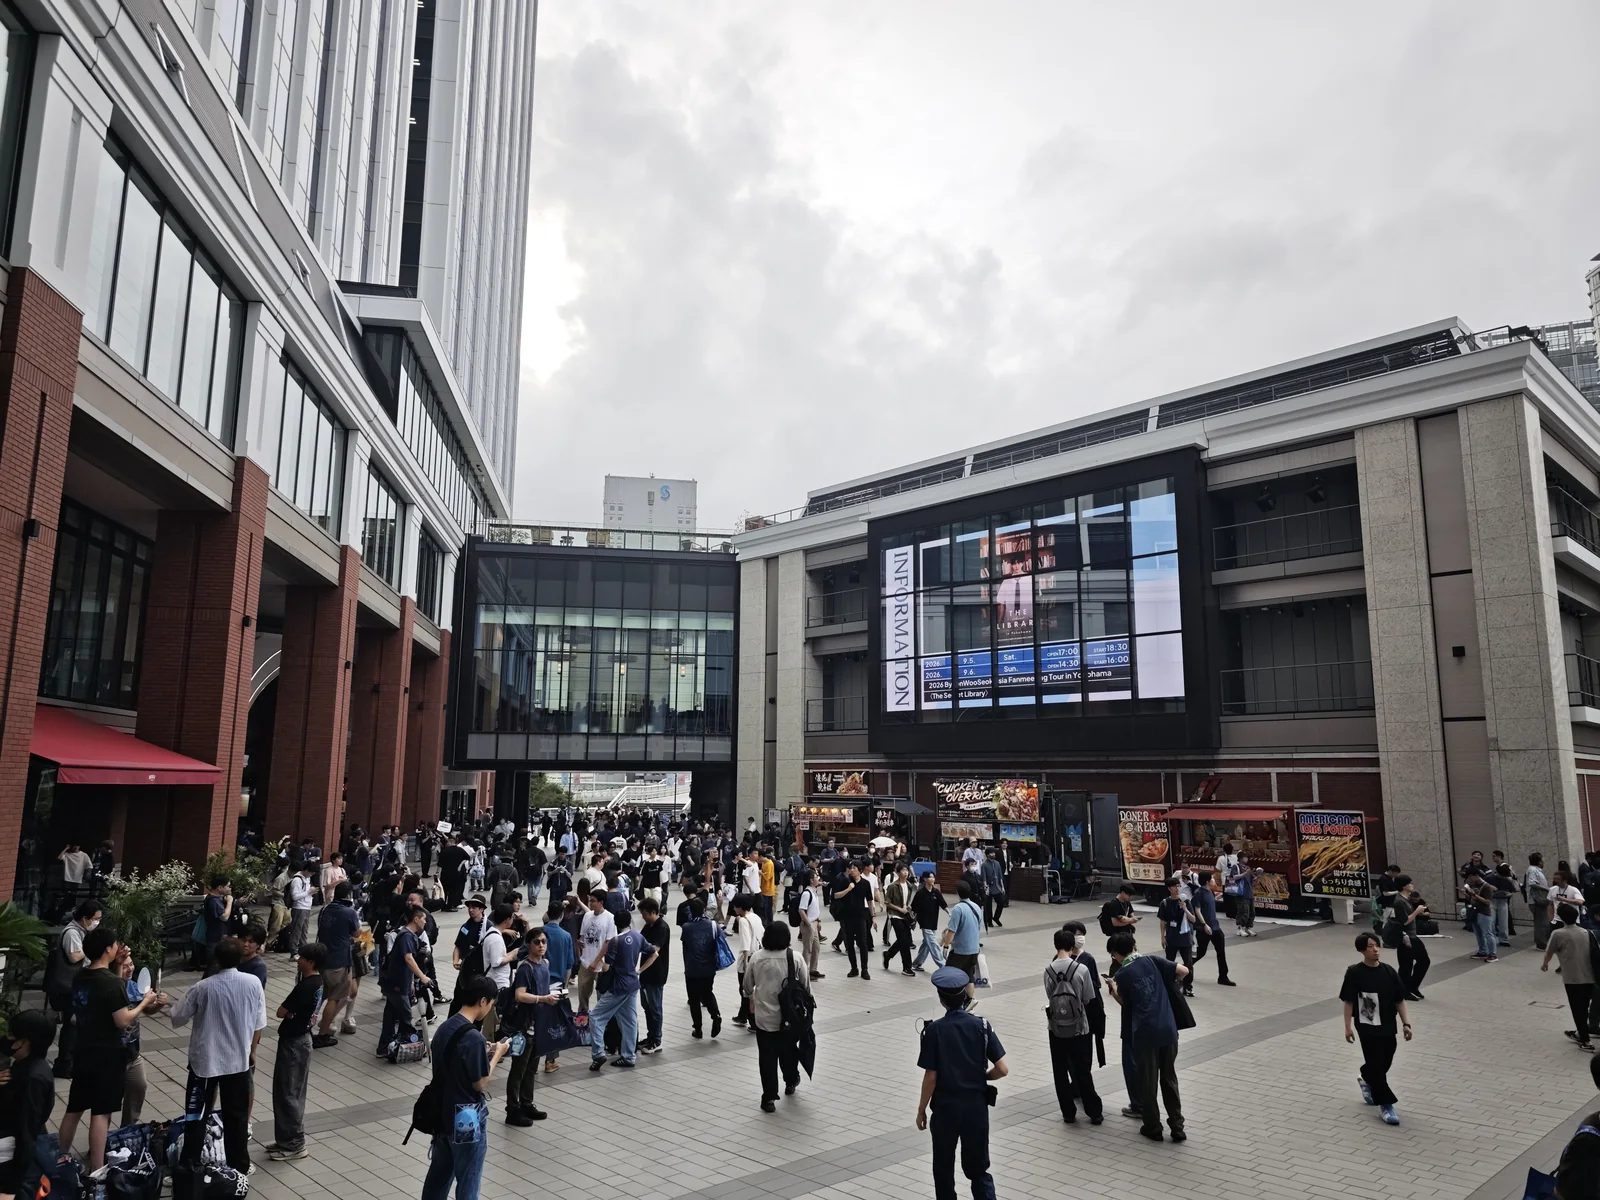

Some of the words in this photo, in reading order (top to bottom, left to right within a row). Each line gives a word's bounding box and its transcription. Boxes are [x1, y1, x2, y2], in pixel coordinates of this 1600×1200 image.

[893, 551, 910, 707] INFORMATION
[996, 620, 1034, 630] LIBRAR
[1058, 648, 1078, 656] 17:00
[1106, 643, 1128, 652] 18:30
[1058, 660, 1078, 668] 14:30
[1106, 656, 1128, 664] 16:00
[1073, 670, 1112, 678] Yoohama
[938, 782, 980, 794] CHICKEN
[972, 790, 995, 800] RICE
[1119, 810, 1150, 822] DONER
[1299, 814, 1350, 825] AMERICAN
[1137, 822, 1168, 832] KEBAB
[1300, 824, 1322, 834] LONG
[1323, 825, 1360, 836] POTATO
[1338, 862, 1366, 870] サクサク
